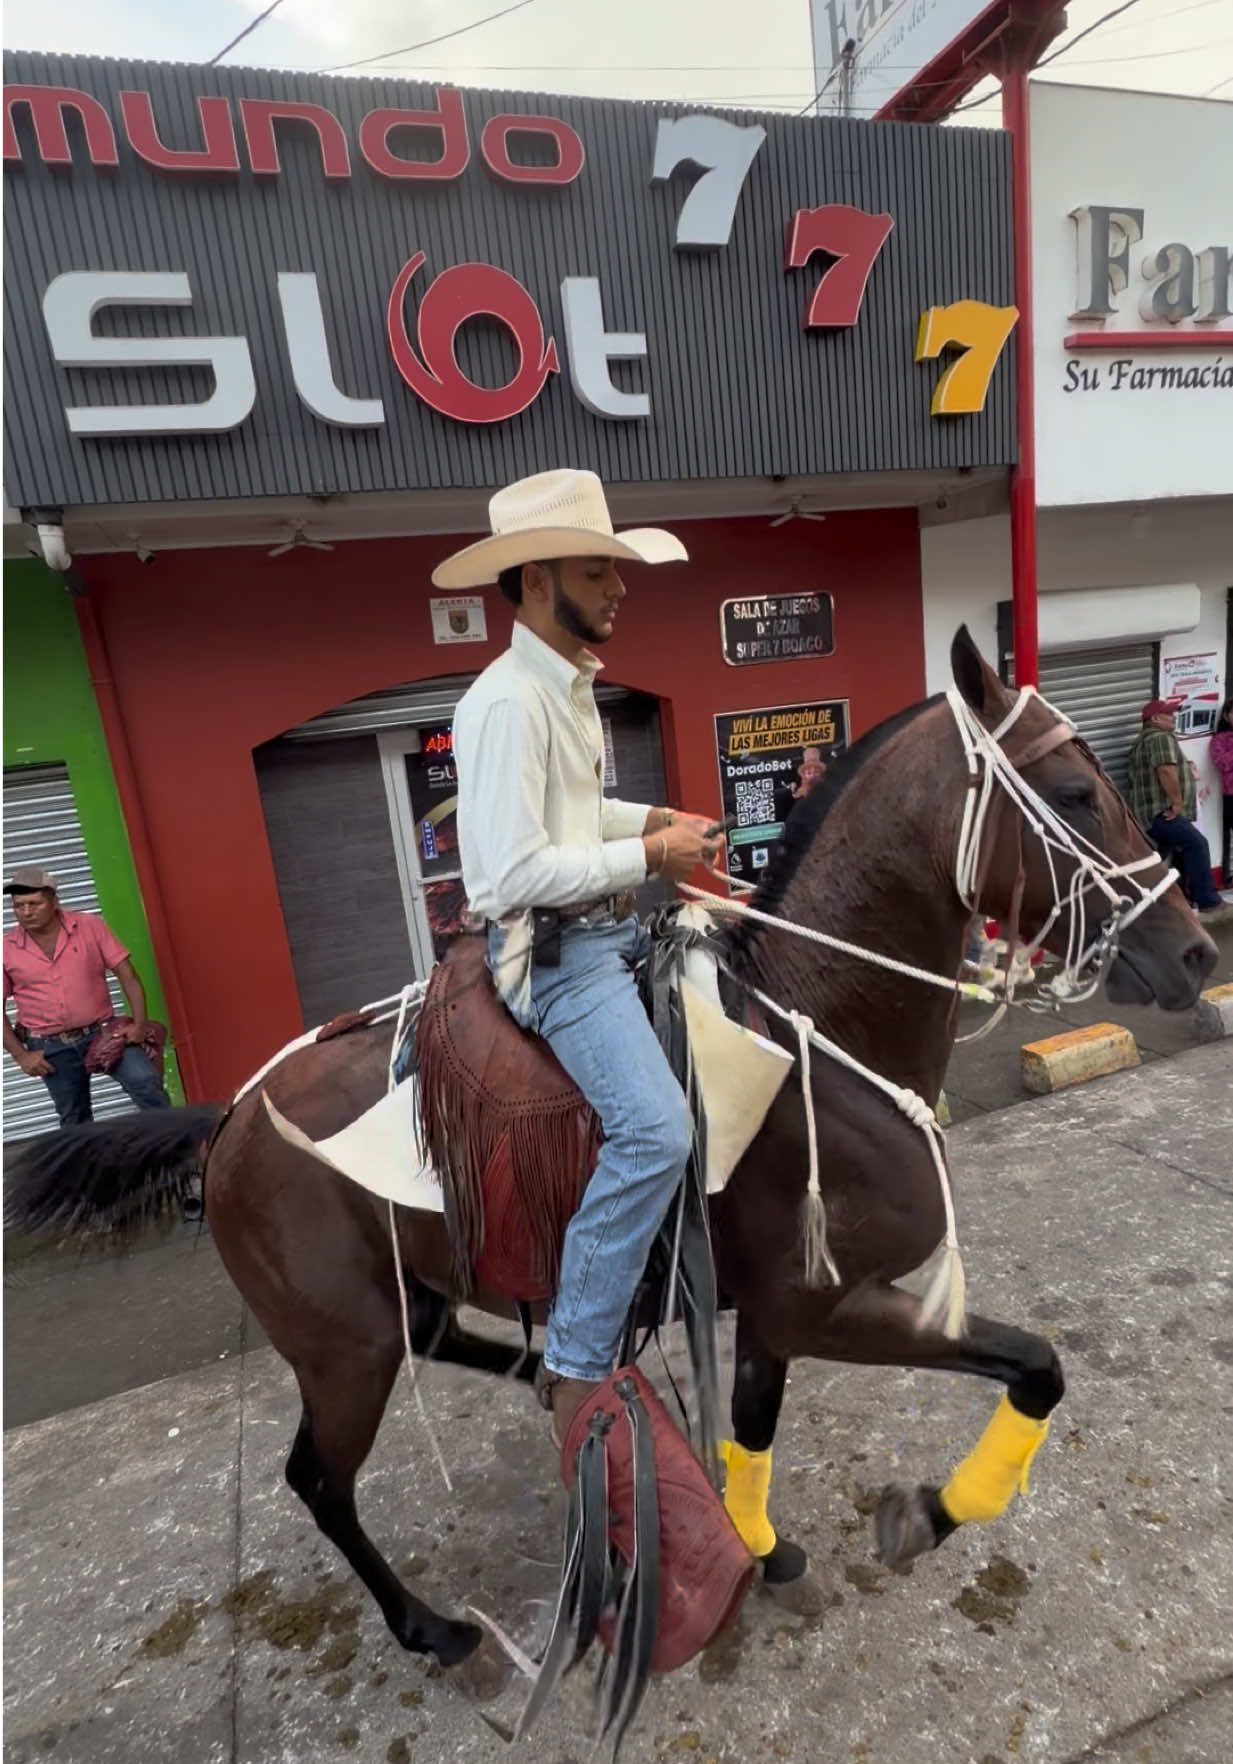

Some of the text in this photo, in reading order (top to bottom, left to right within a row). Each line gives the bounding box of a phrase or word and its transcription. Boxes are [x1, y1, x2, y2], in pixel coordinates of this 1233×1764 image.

[3, 84, 585, 187] mundo
[652, 115, 767, 247] 7
[785, 203, 895, 331] 7
[915, 299, 1021, 415] 7
[1062, 359, 1101, 393] Su
[733, 602, 761, 620] SALA
[779, 597, 821, 617] JUEGOS
[772, 617, 801, 637] AZAR
[736, 639, 772, 659] SUPER
[781, 635, 823, 655] BOACO
[755, 715, 769, 731] LA
[770, 708, 817, 730] EMOCIÓN
[817, 708, 833, 724] DE
[731, 726, 831, 751] LAS MEJORES LIGAS
[726, 759, 793, 777] DoradoBot
